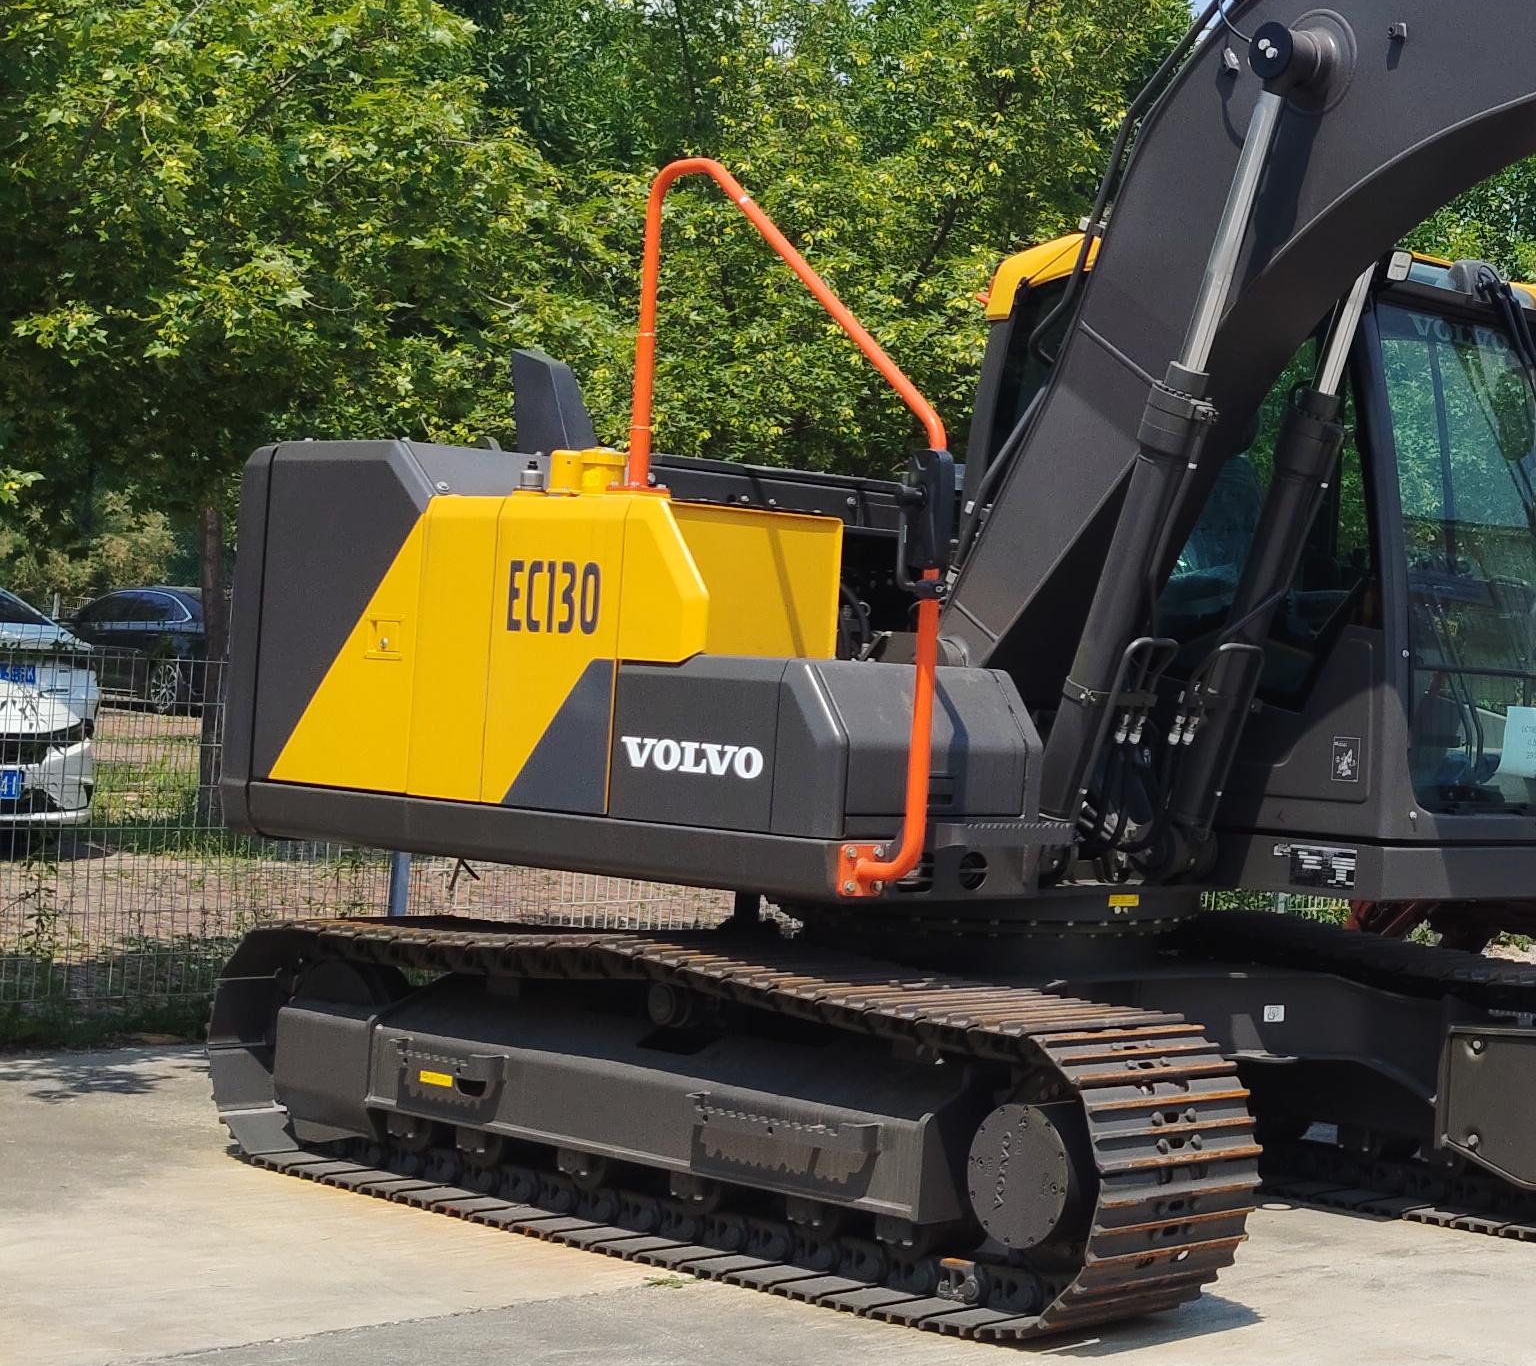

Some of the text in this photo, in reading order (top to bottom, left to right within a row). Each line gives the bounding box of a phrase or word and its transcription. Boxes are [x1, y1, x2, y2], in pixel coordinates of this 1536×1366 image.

[507, 559, 600, 635] EC130
[621, 735, 764, 779] VOLVO
[992, 1131, 1012, 1211] VOLVO
